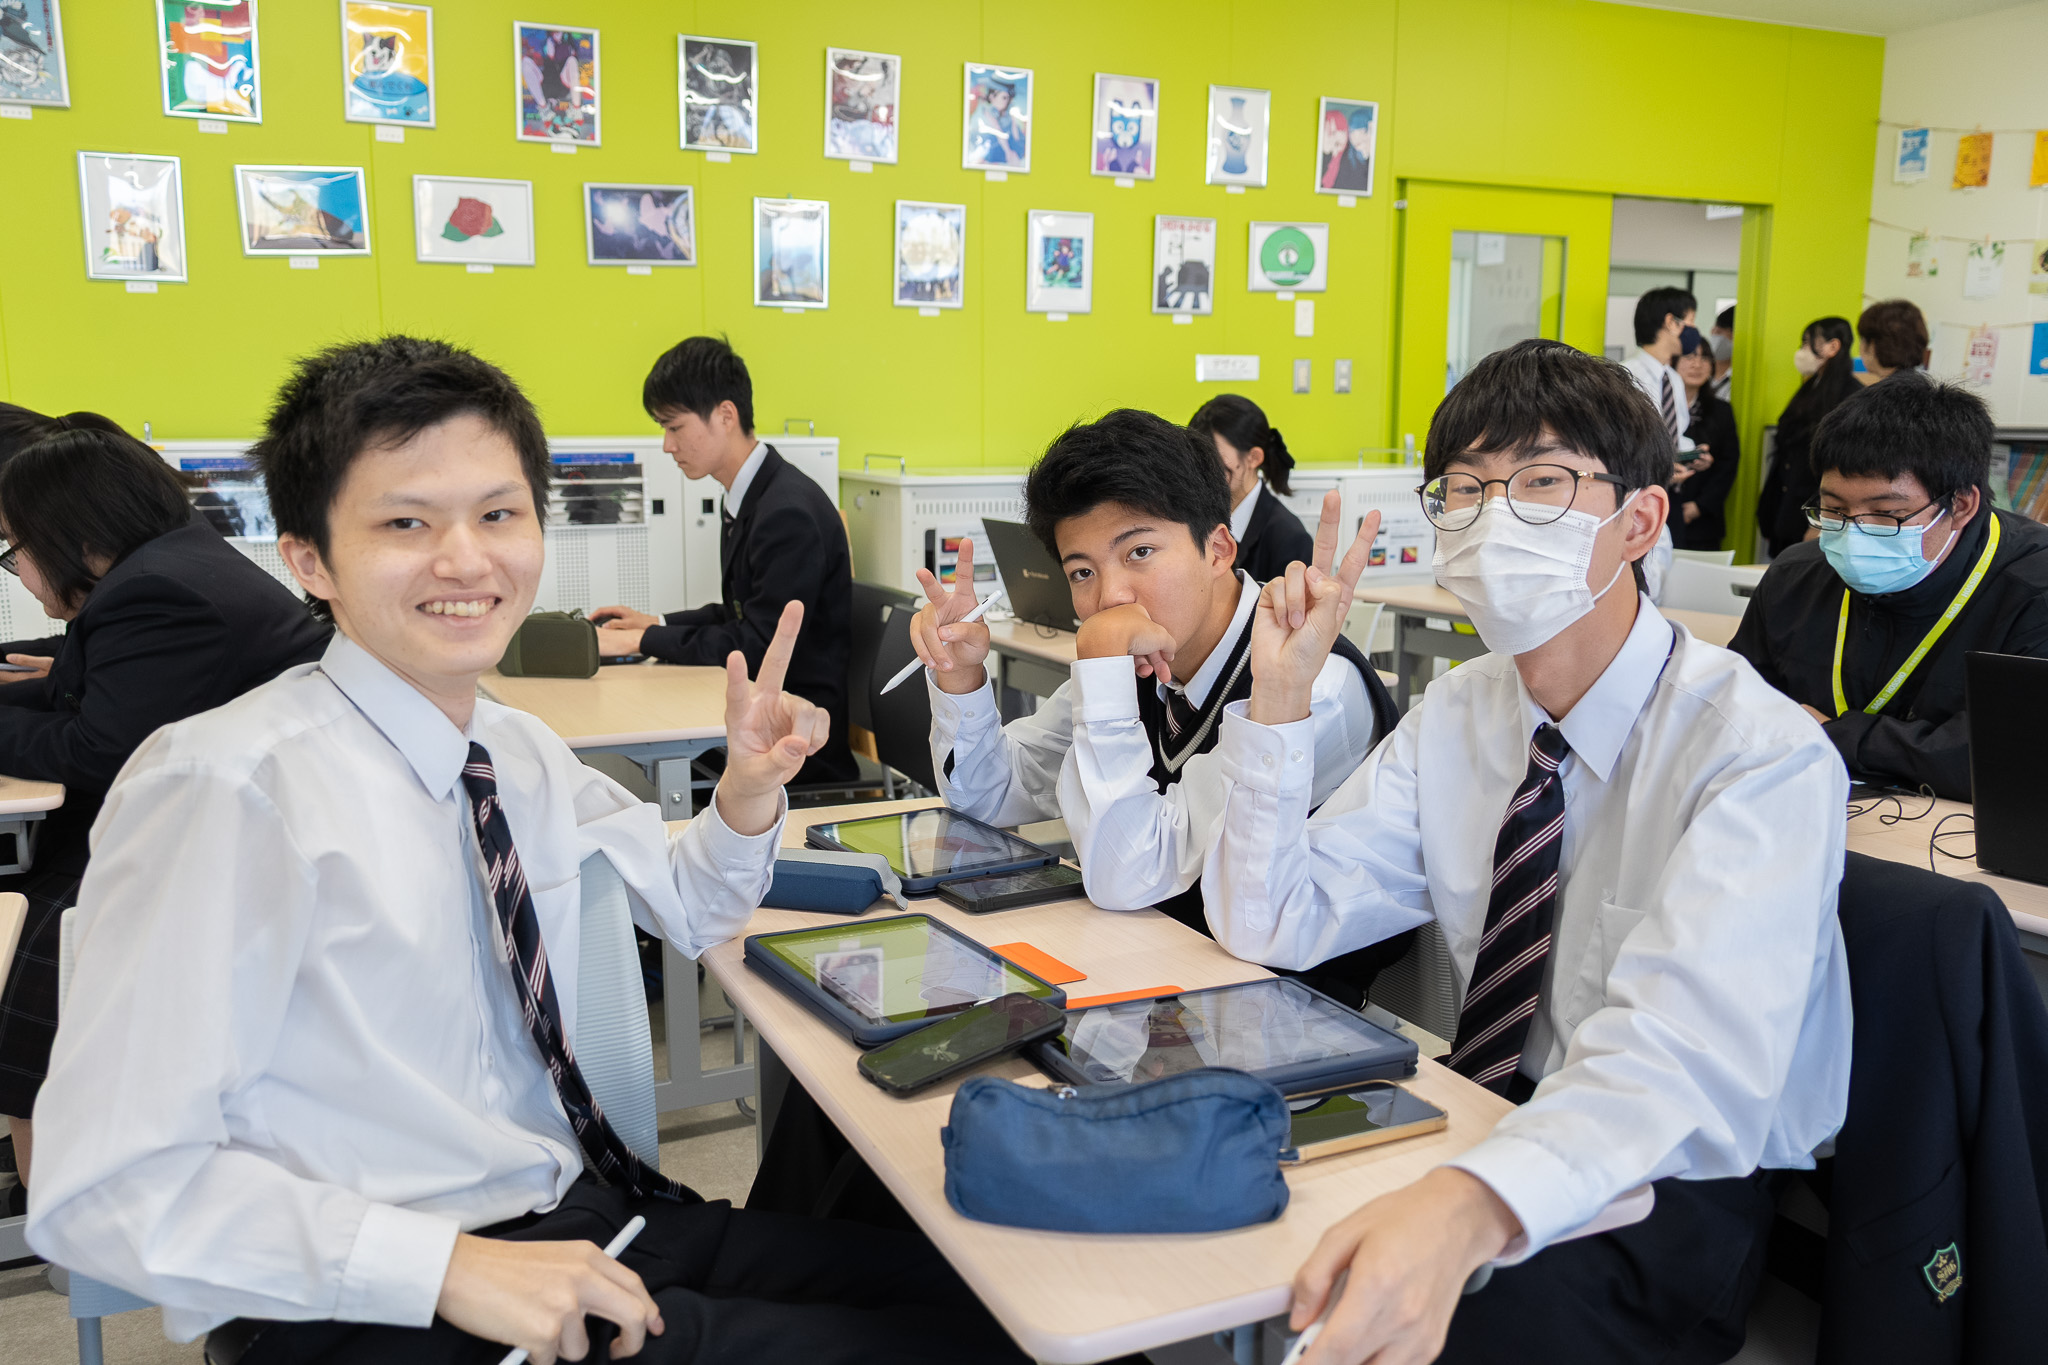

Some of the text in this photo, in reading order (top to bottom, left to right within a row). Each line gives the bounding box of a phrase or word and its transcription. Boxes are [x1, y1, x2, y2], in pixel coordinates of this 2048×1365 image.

[1945, 571, 1982, 620] SAGA HOSSHO
[1870, 671, 1907, 711] SAGA HOSSHO
